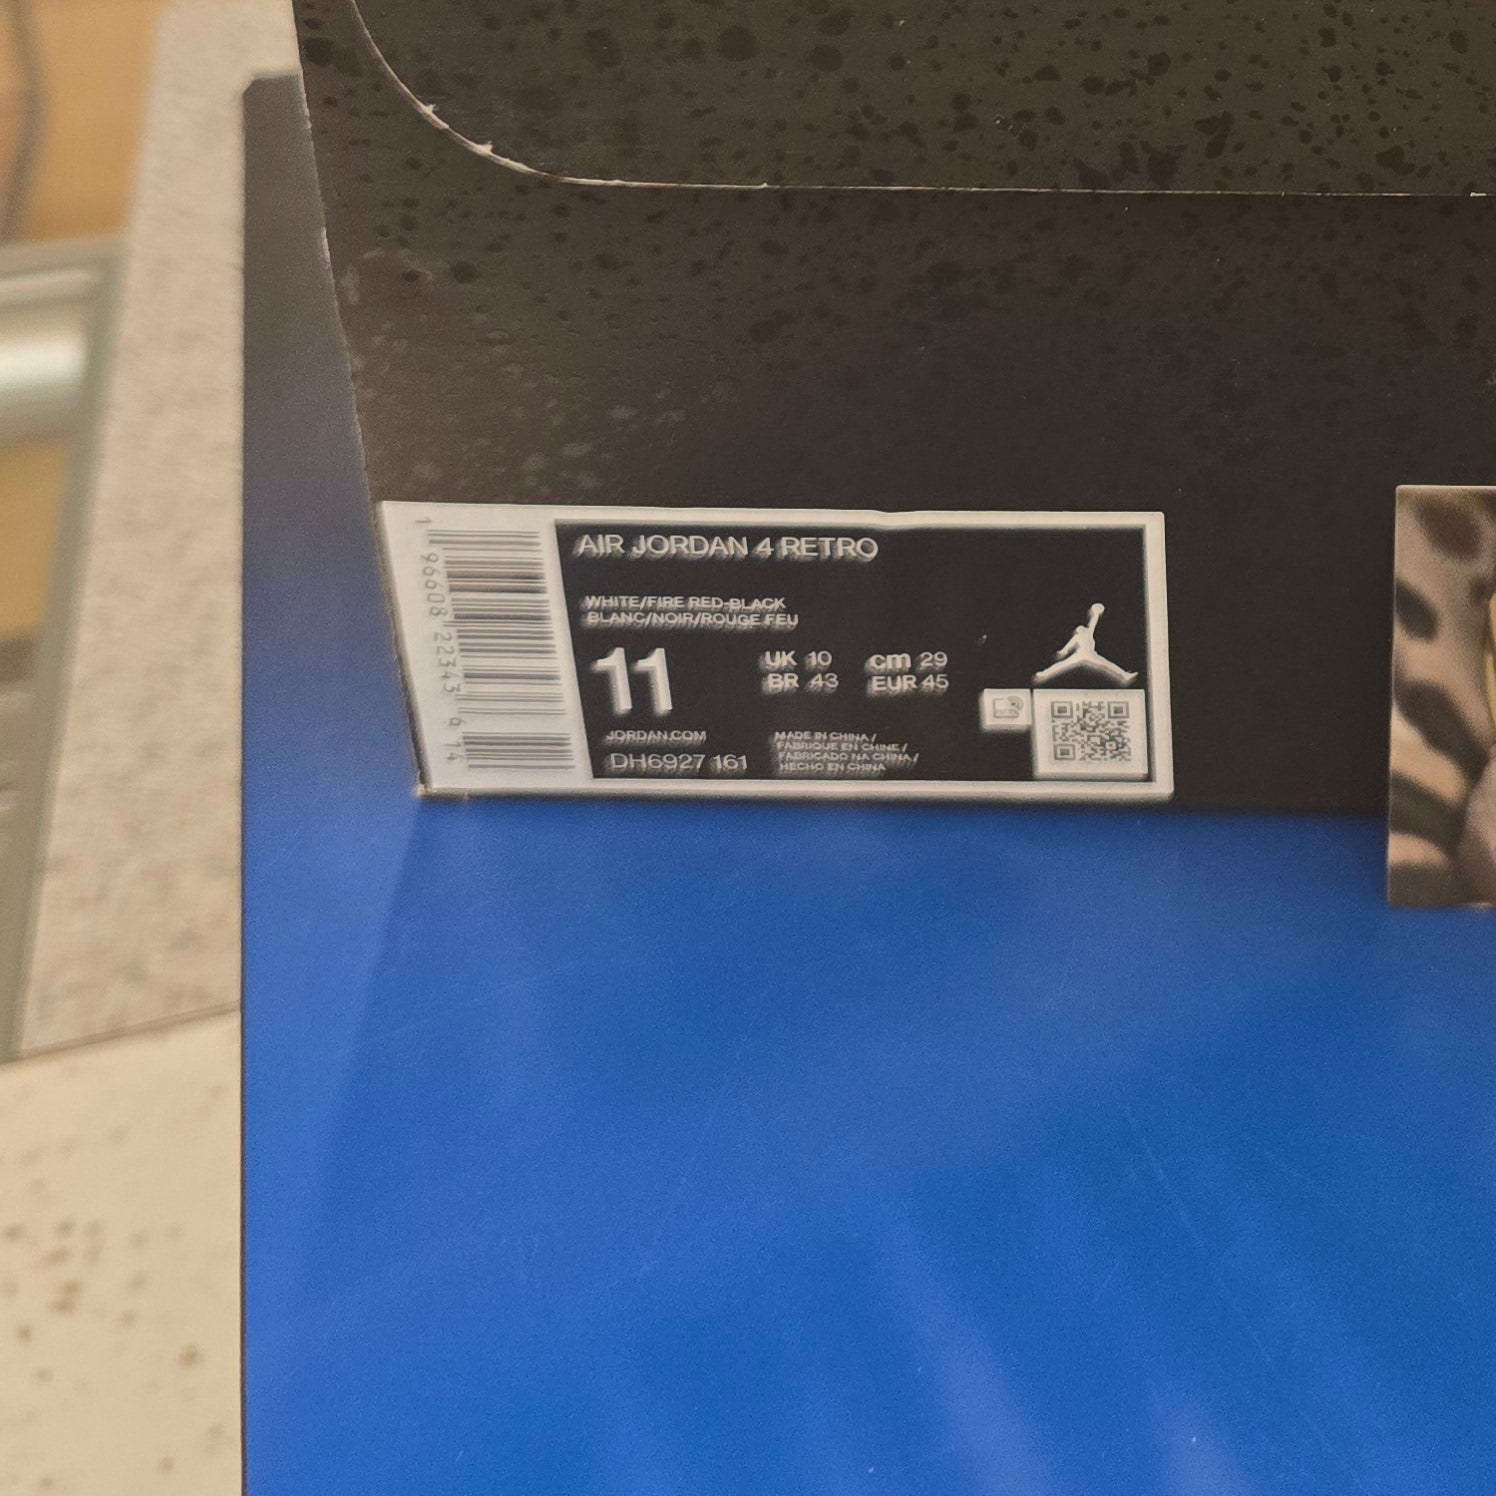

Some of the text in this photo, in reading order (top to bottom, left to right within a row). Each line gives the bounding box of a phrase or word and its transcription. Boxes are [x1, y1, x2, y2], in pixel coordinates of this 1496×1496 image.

[577, 534, 879, 560] AIR JORDAN 4 RETRO
[420, 551, 449, 618] 96608
[584, 595, 787, 611] WHITE/FIRE RED-BLACK
[586, 611, 799, 628] BLANC/NOIR/ROUGE FEU
[432, 631, 462, 695] 22343
[763, 651, 833, 668] UK 10
[867, 652, 948, 672] cm 29
[593, 647, 673, 715] 11
[765, 673, 839, 690] BR 43
[870, 675, 950, 693] EUR 45
[606, 730, 708, 743] JORDAN.COM
[774, 730, 812, 741] MADE
[814, 731, 828, 741] IN
[841, 742, 858, 752] EN
[610, 753, 748, 771] DH6927 161
[779, 762, 886, 772] HECHO EN CHINA
